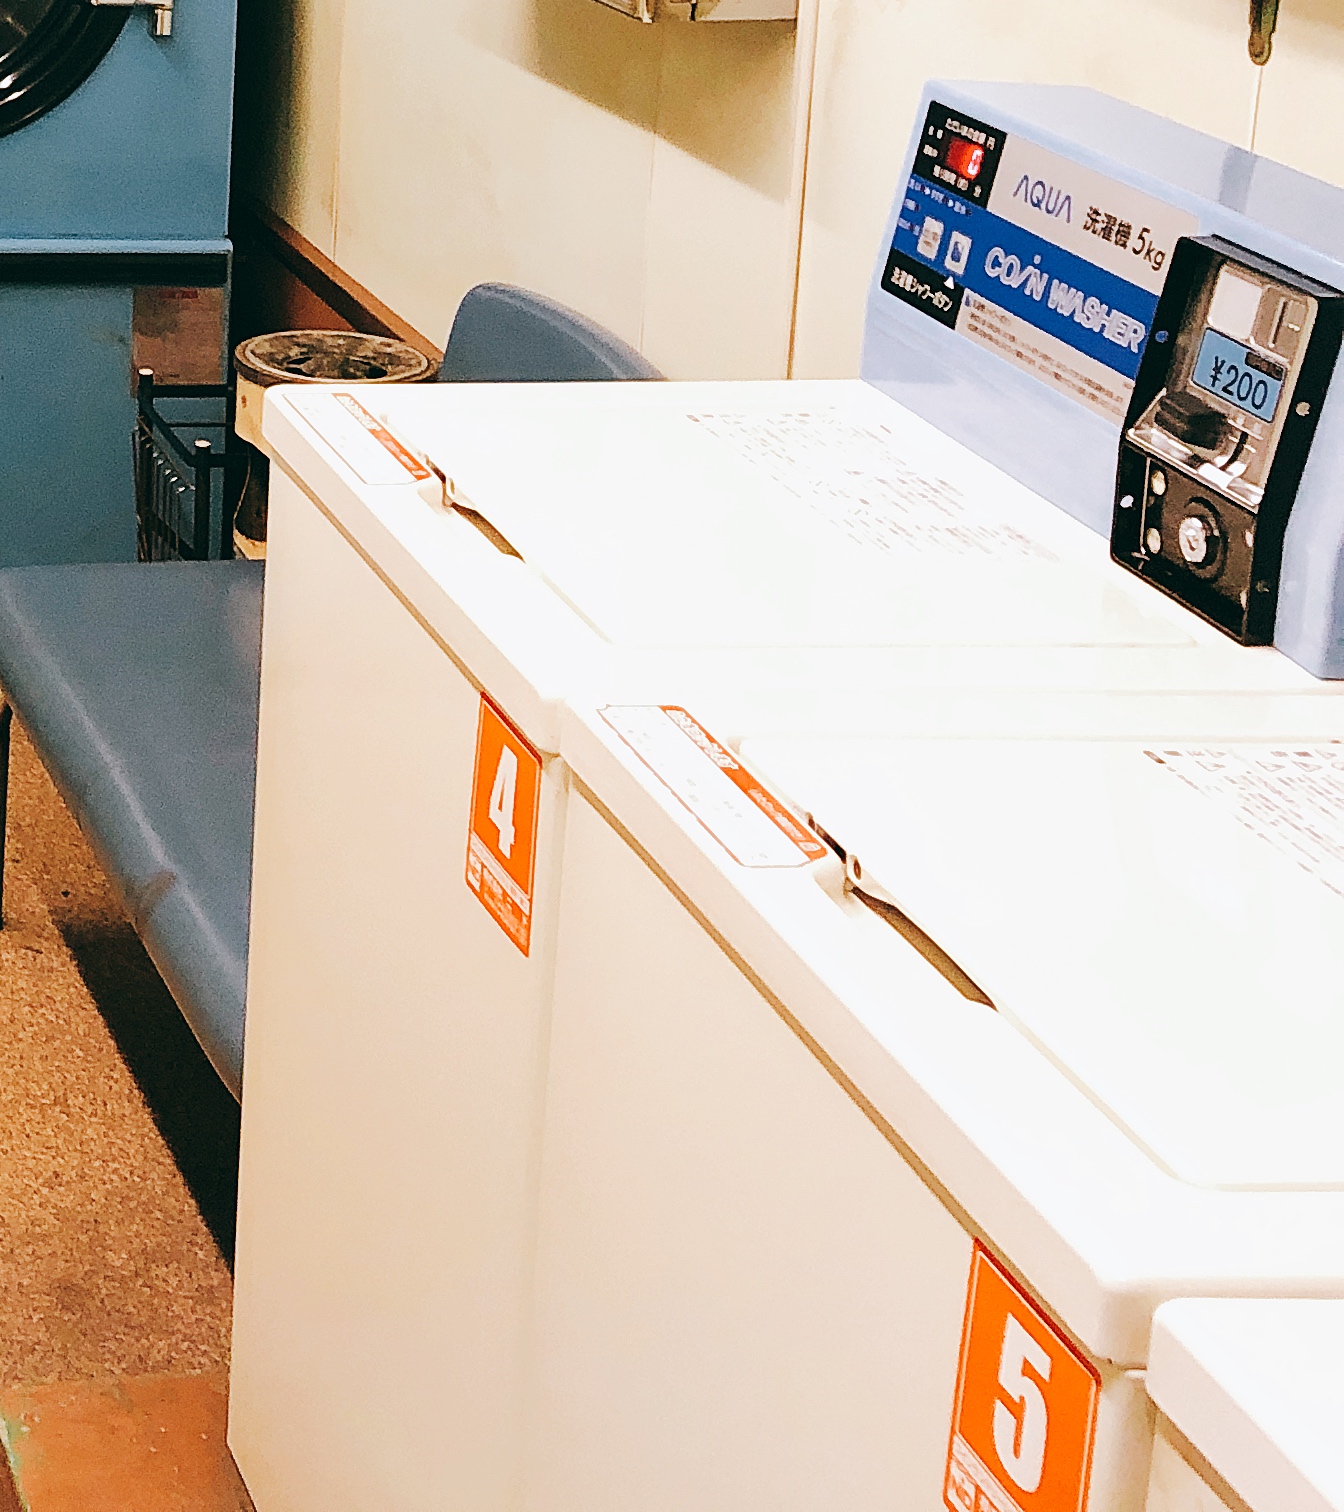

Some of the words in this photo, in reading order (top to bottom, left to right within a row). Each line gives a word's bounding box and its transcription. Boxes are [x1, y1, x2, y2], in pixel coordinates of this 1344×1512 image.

[1012, 174, 1072, 224] AQUA
[1082, 205, 1133, 250] 洗濯機
[1131, 226, 1166, 272] 5kg
[1047, 278, 1147, 354] WASHER
[1209, 355, 1269, 410] ¥200
[487, 742, 519, 861] 4
[992, 1310, 1053, 1494] 5
